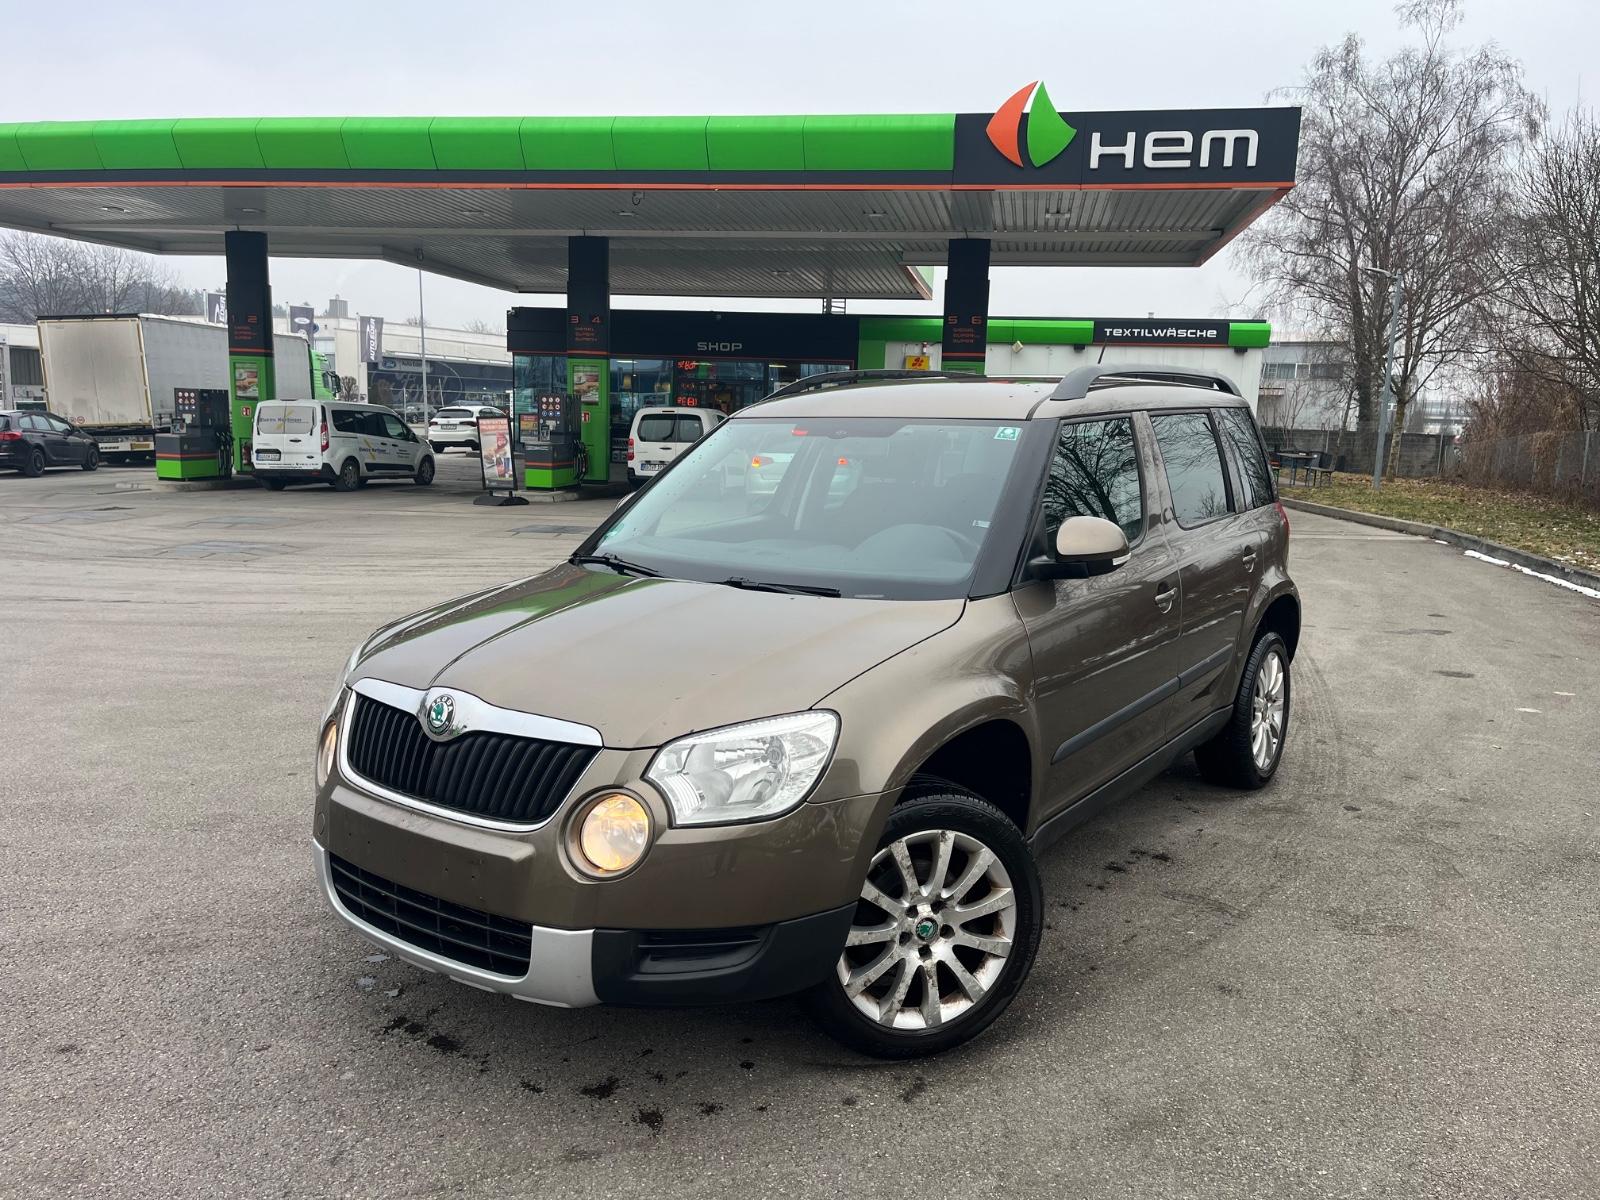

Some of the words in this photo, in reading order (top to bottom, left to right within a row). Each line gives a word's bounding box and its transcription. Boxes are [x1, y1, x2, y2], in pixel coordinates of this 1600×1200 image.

[570, 315, 579, 324] 3
[591, 315, 601, 324] 4
[947, 315, 958, 325] 5
[971, 315, 982, 325] 6
[696, 341, 743, 352] SHOP
